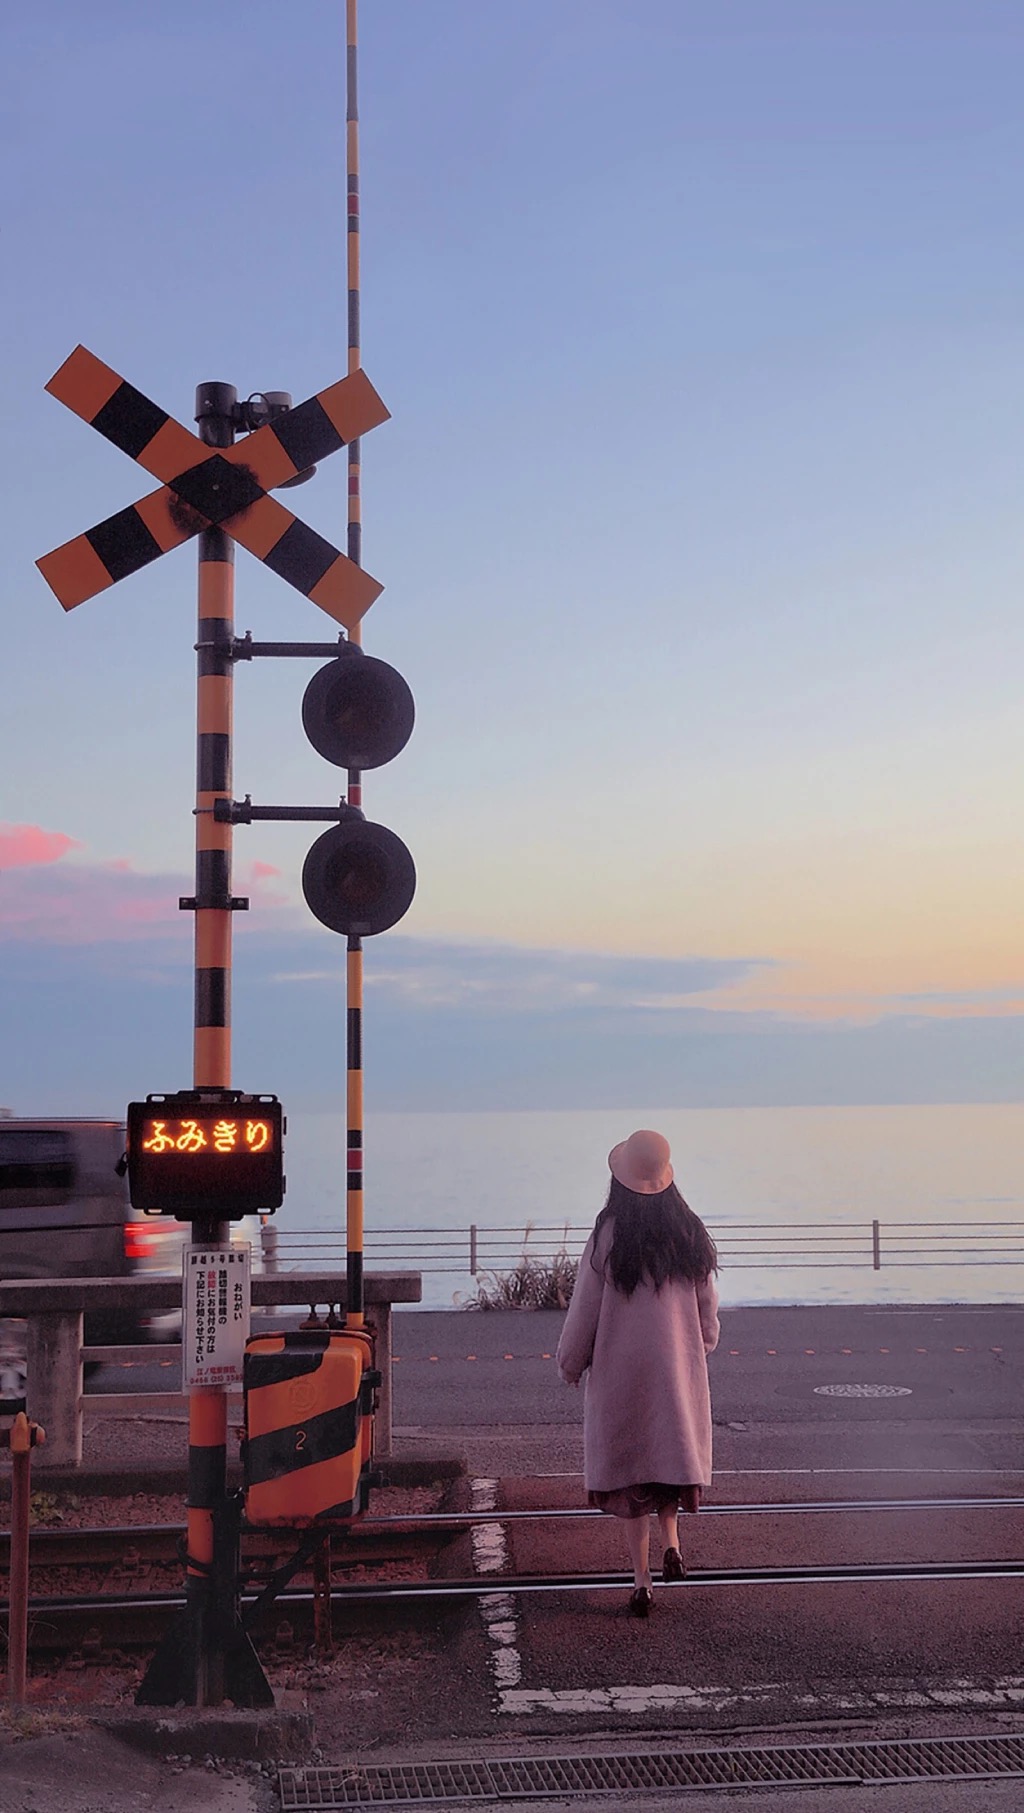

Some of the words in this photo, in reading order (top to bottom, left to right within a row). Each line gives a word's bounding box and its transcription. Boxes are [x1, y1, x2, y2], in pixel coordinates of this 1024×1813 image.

[143, 1121, 268, 1152] ふみきり
[195, 1270, 206, 1364] 下記にお知らせ下さい
[207, 1270, 217, 1354] 故障にお気付の方は
[234, 1283, 243, 1321] おねがい
[295, 1430, 307, 1451] 2
